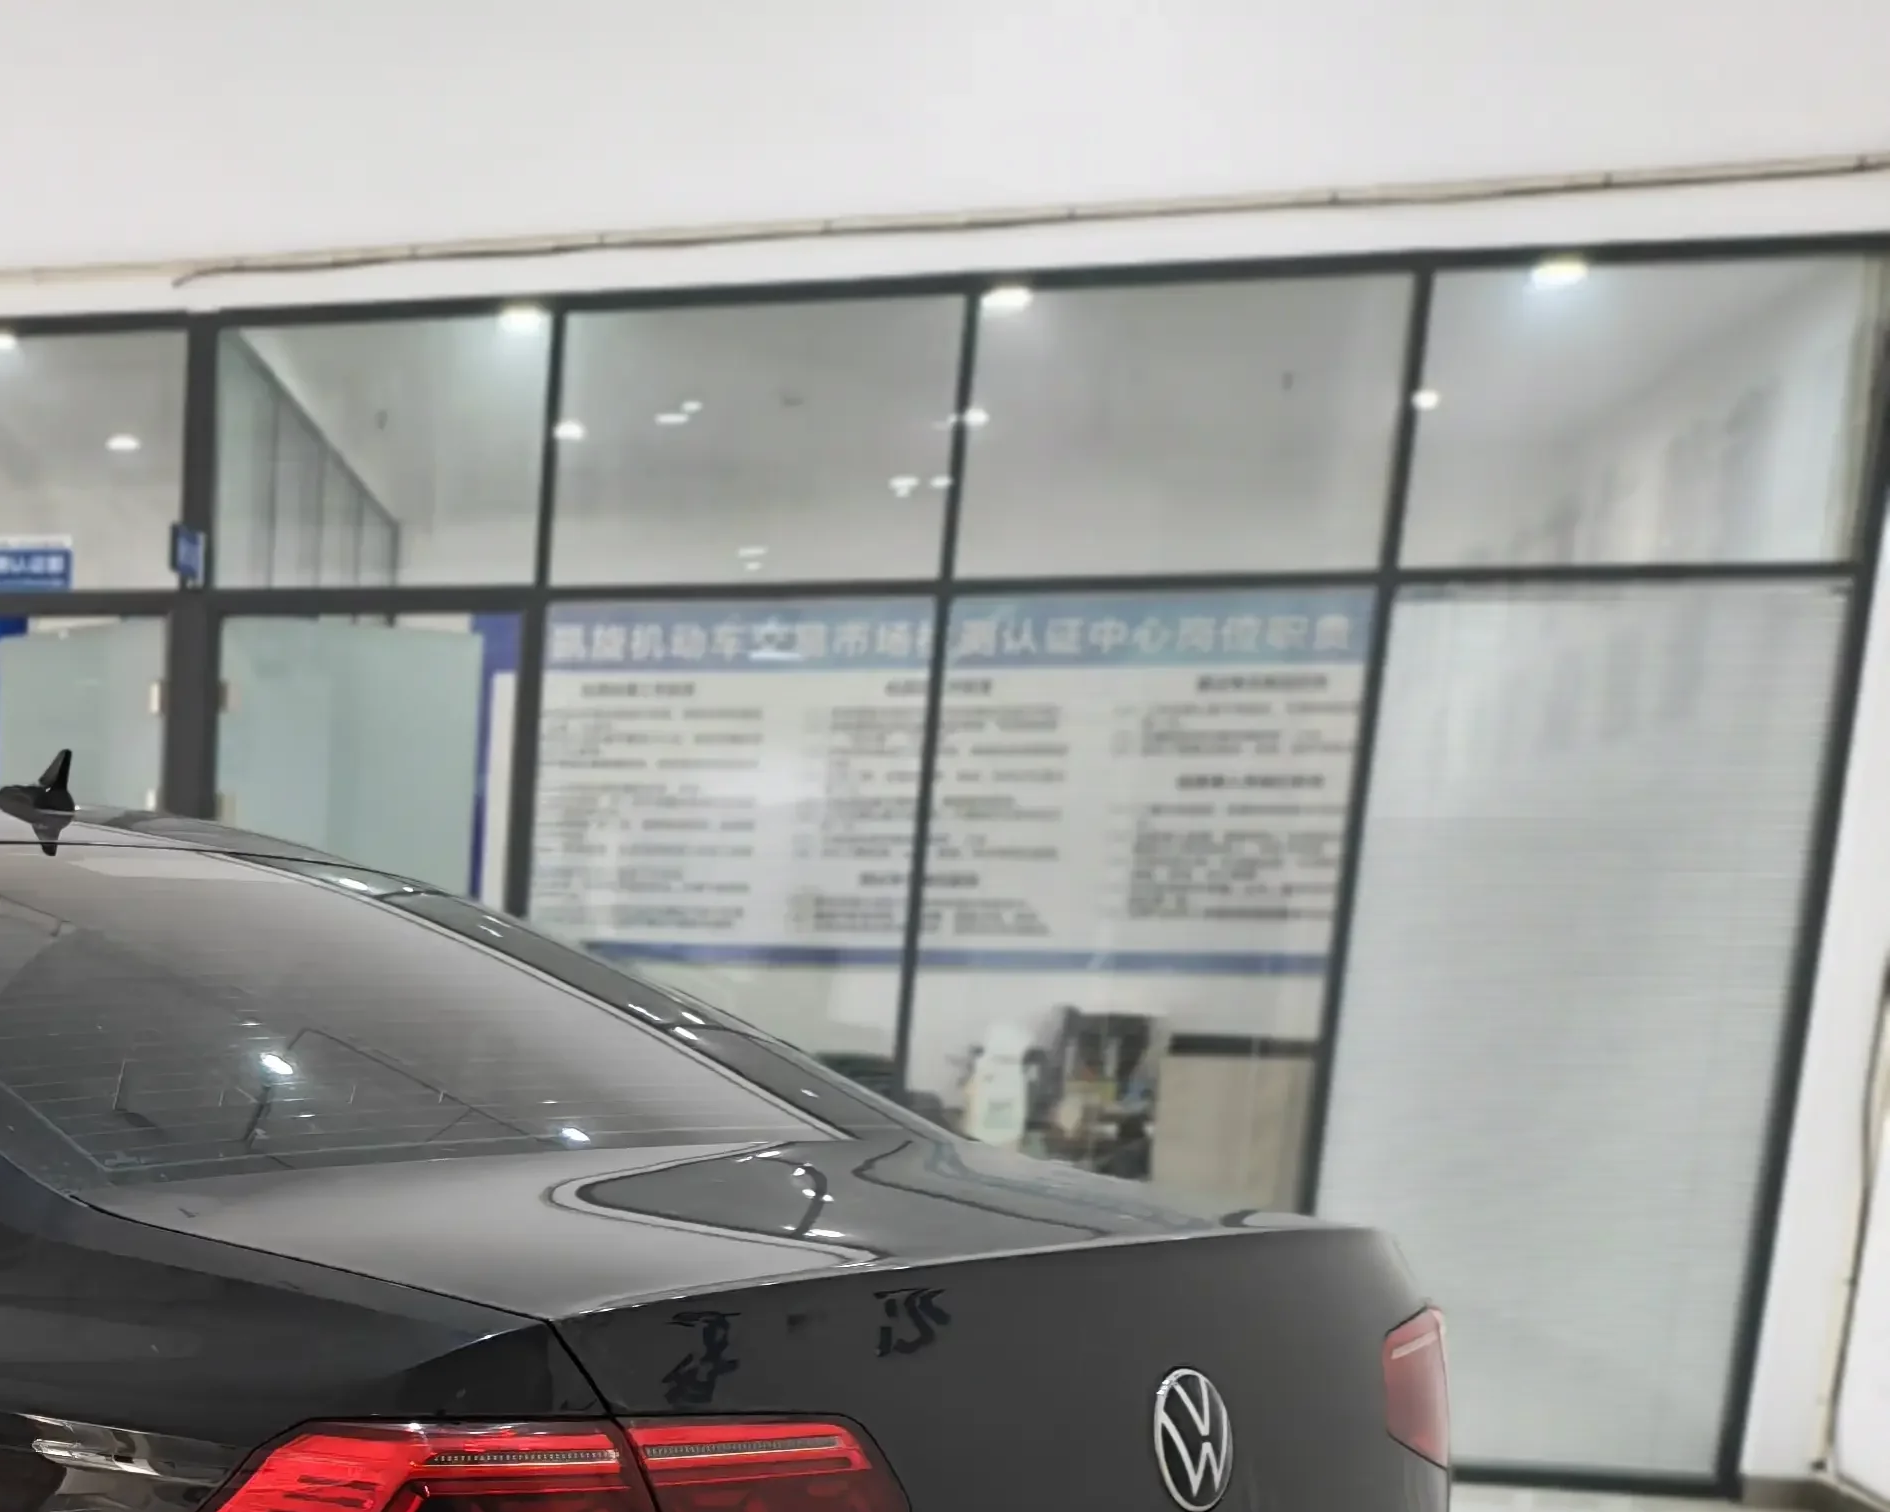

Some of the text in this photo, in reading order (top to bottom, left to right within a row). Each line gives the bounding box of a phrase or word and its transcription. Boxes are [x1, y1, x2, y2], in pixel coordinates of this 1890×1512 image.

[551, 612, 1350, 662] 旋机动车交易市场测认证中心岗位职责
